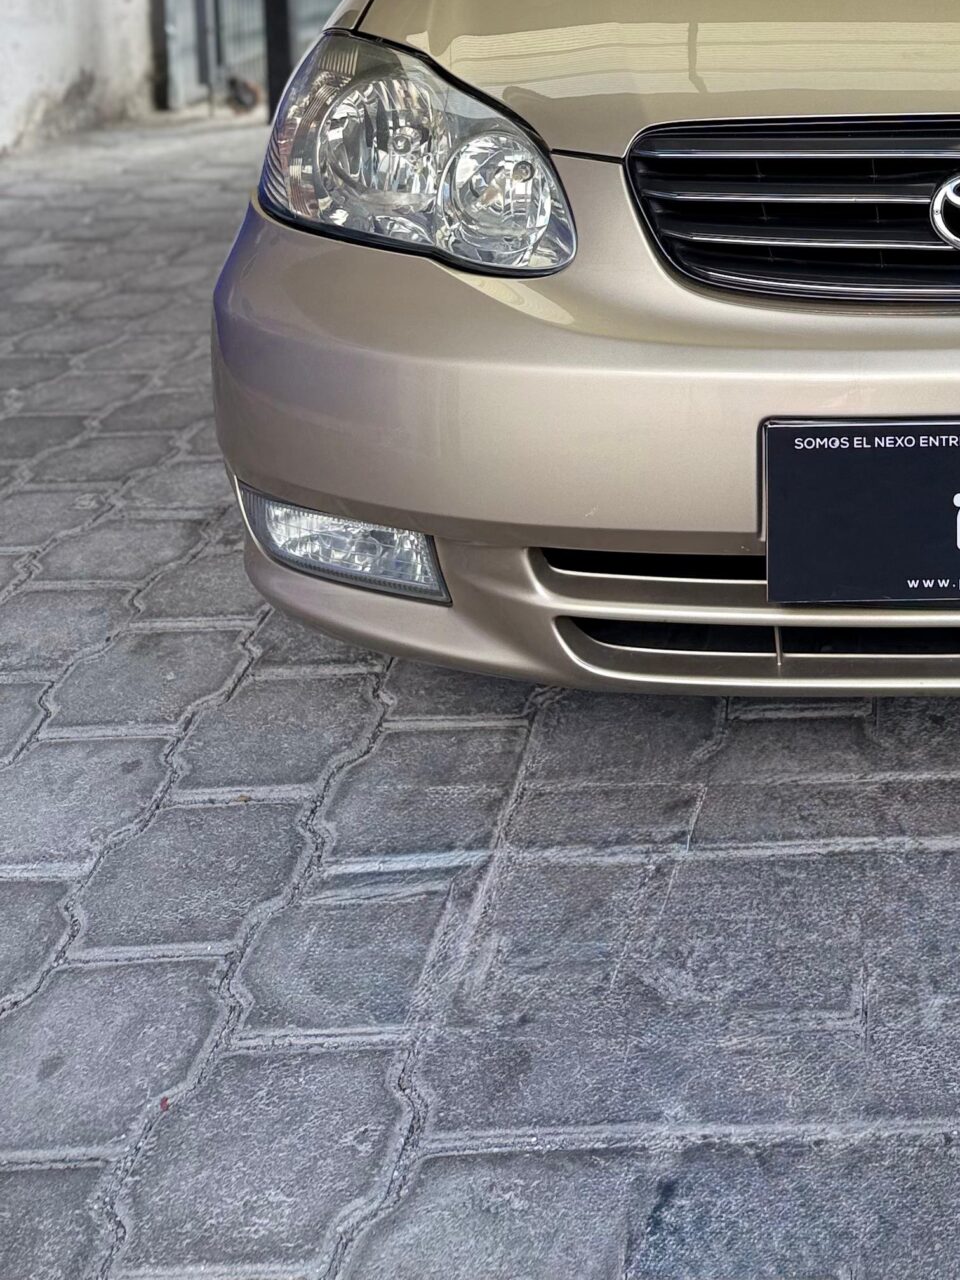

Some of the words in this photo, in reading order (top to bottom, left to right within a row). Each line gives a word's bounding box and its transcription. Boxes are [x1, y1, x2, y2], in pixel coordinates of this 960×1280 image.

[794, 436, 850, 450] SOMOS
[853, 436, 871, 448] EL
[874, 435, 916, 448] NEXO
